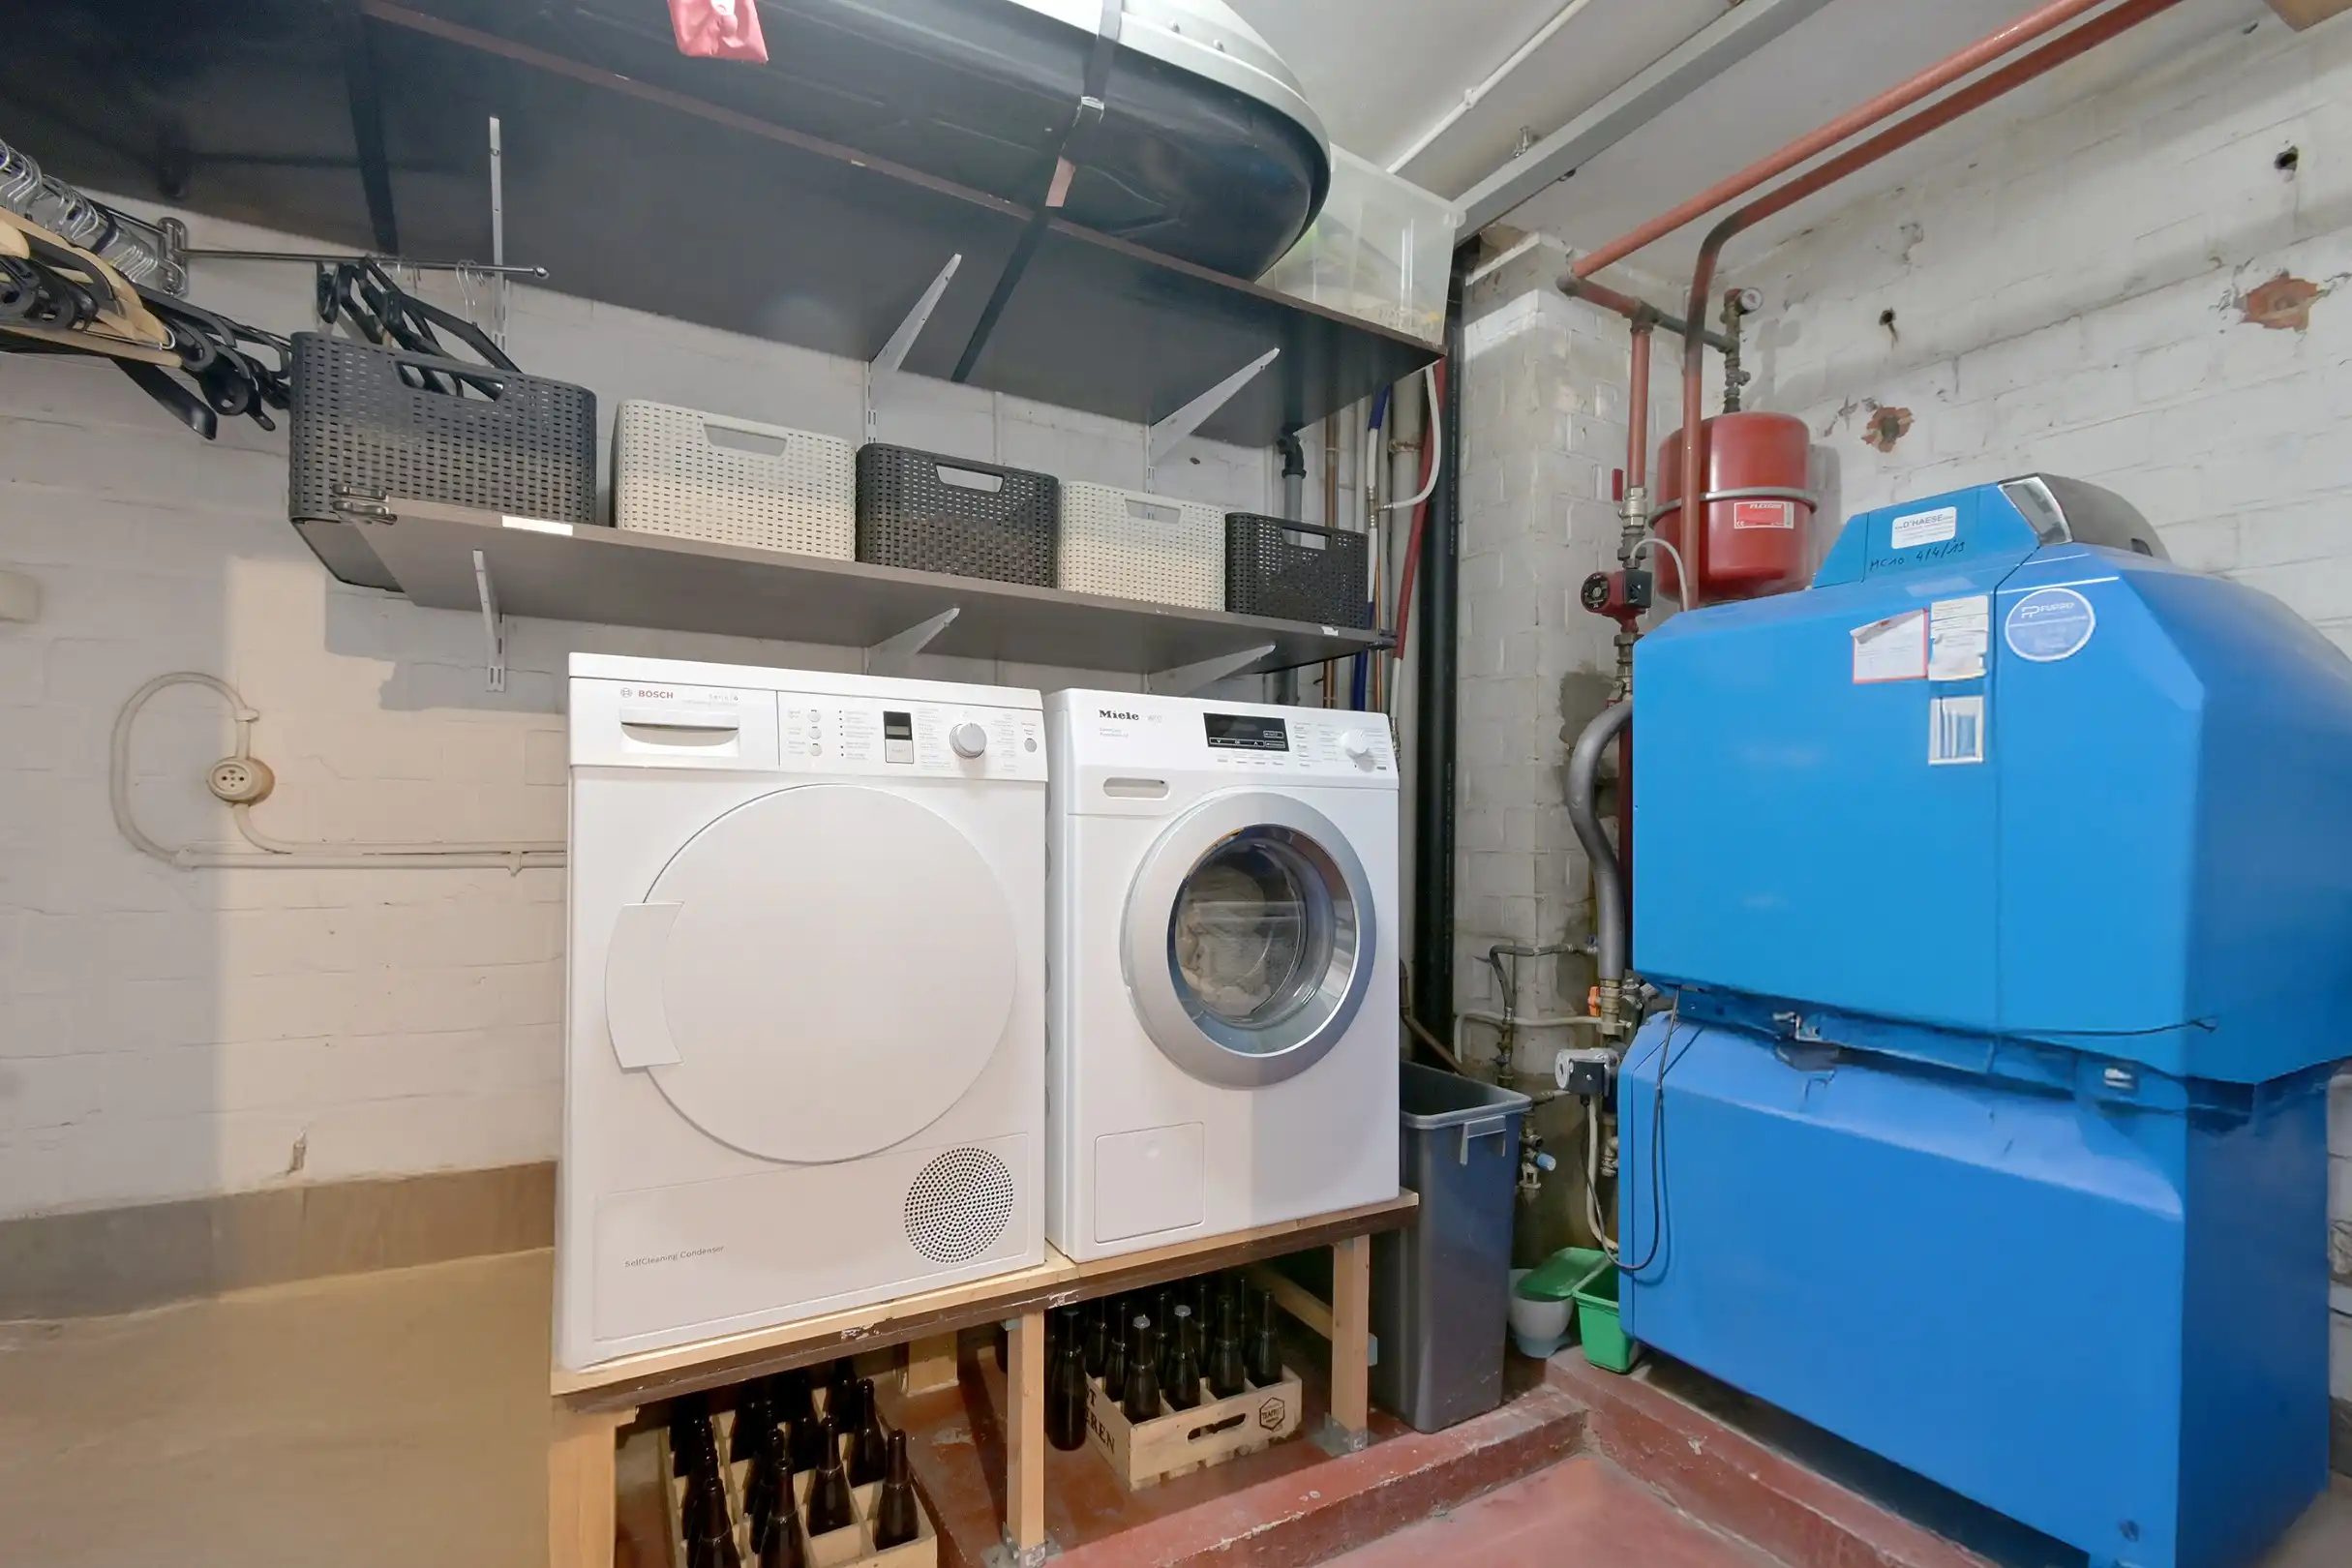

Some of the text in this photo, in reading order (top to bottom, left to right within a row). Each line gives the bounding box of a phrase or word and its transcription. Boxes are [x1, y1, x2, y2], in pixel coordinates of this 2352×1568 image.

[638, 689, 674, 699] BOSCH
[1099, 709, 1139, 720] Miele
[624, 1245, 725, 1268] SelfCleaning Condenser
